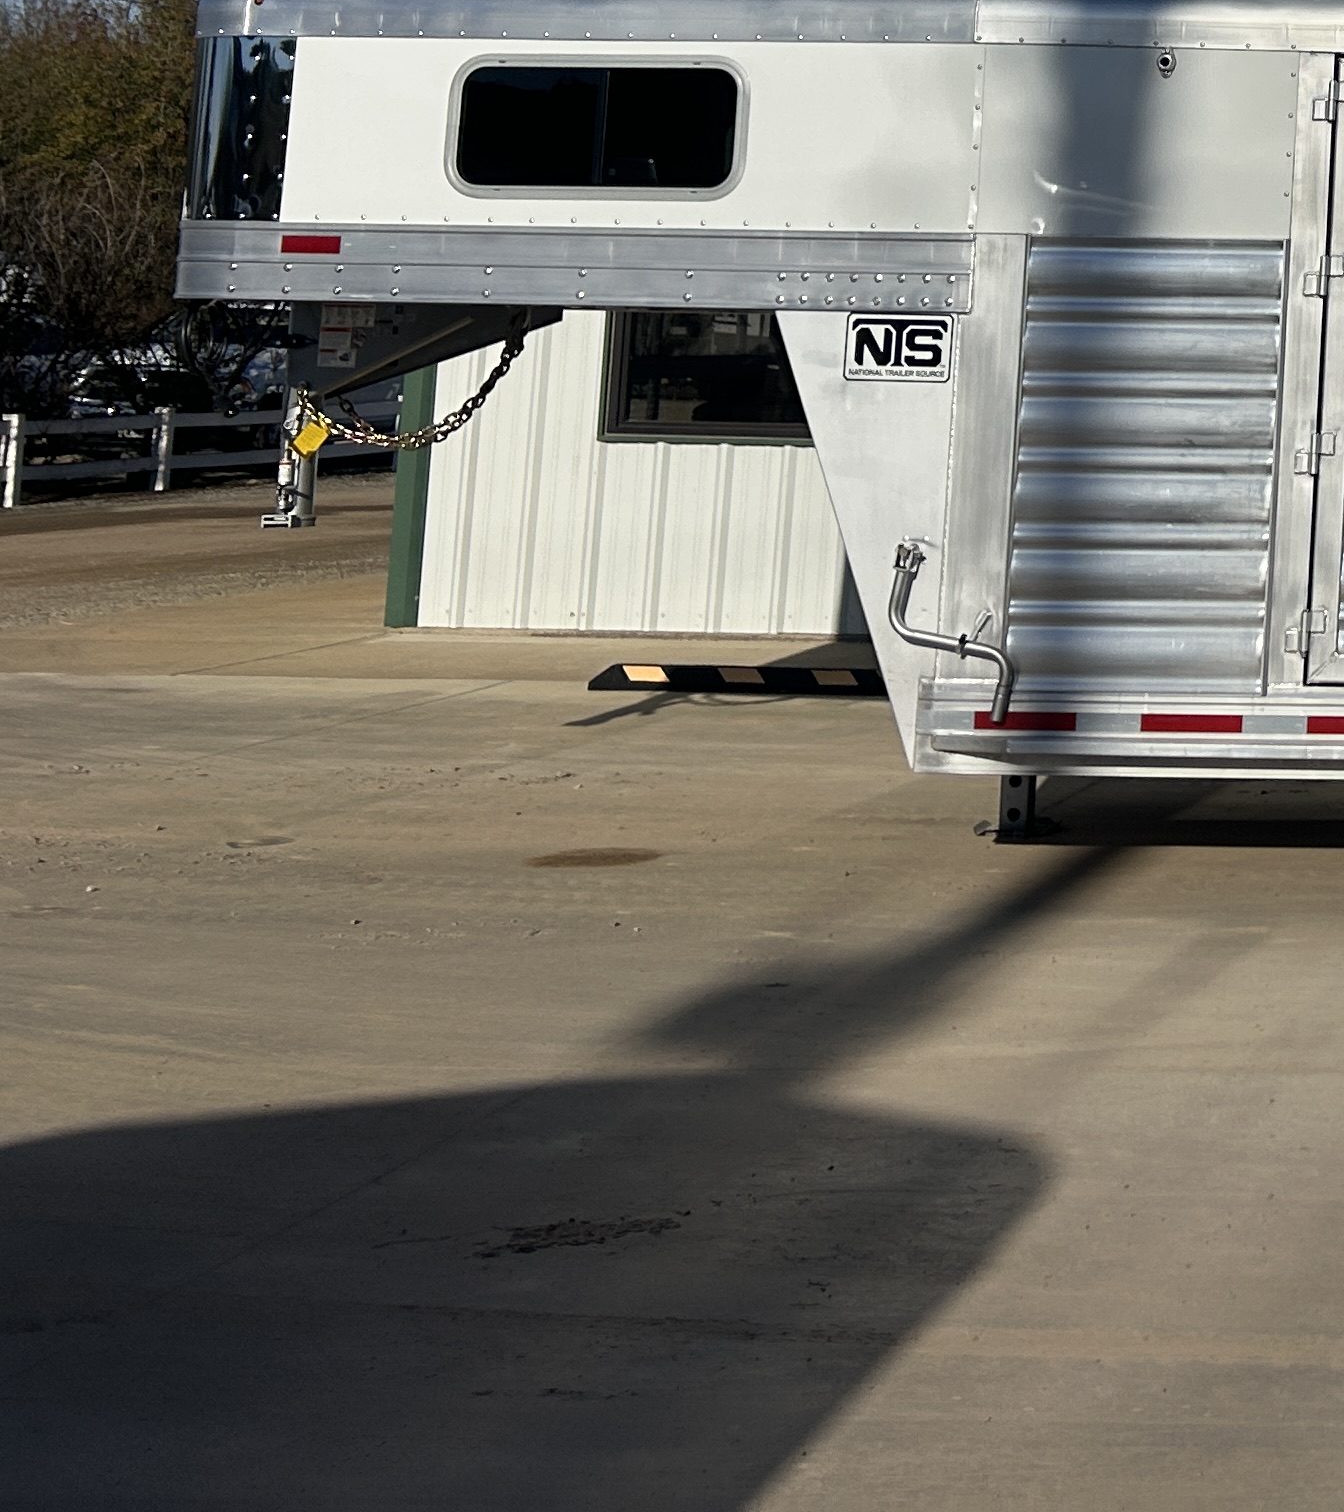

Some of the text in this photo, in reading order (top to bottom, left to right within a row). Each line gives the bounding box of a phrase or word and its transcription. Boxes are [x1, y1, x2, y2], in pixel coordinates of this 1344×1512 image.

[852, 318, 948, 367] NTS
[848, 368, 945, 378] NATIONAL TRAILER SOURCE
